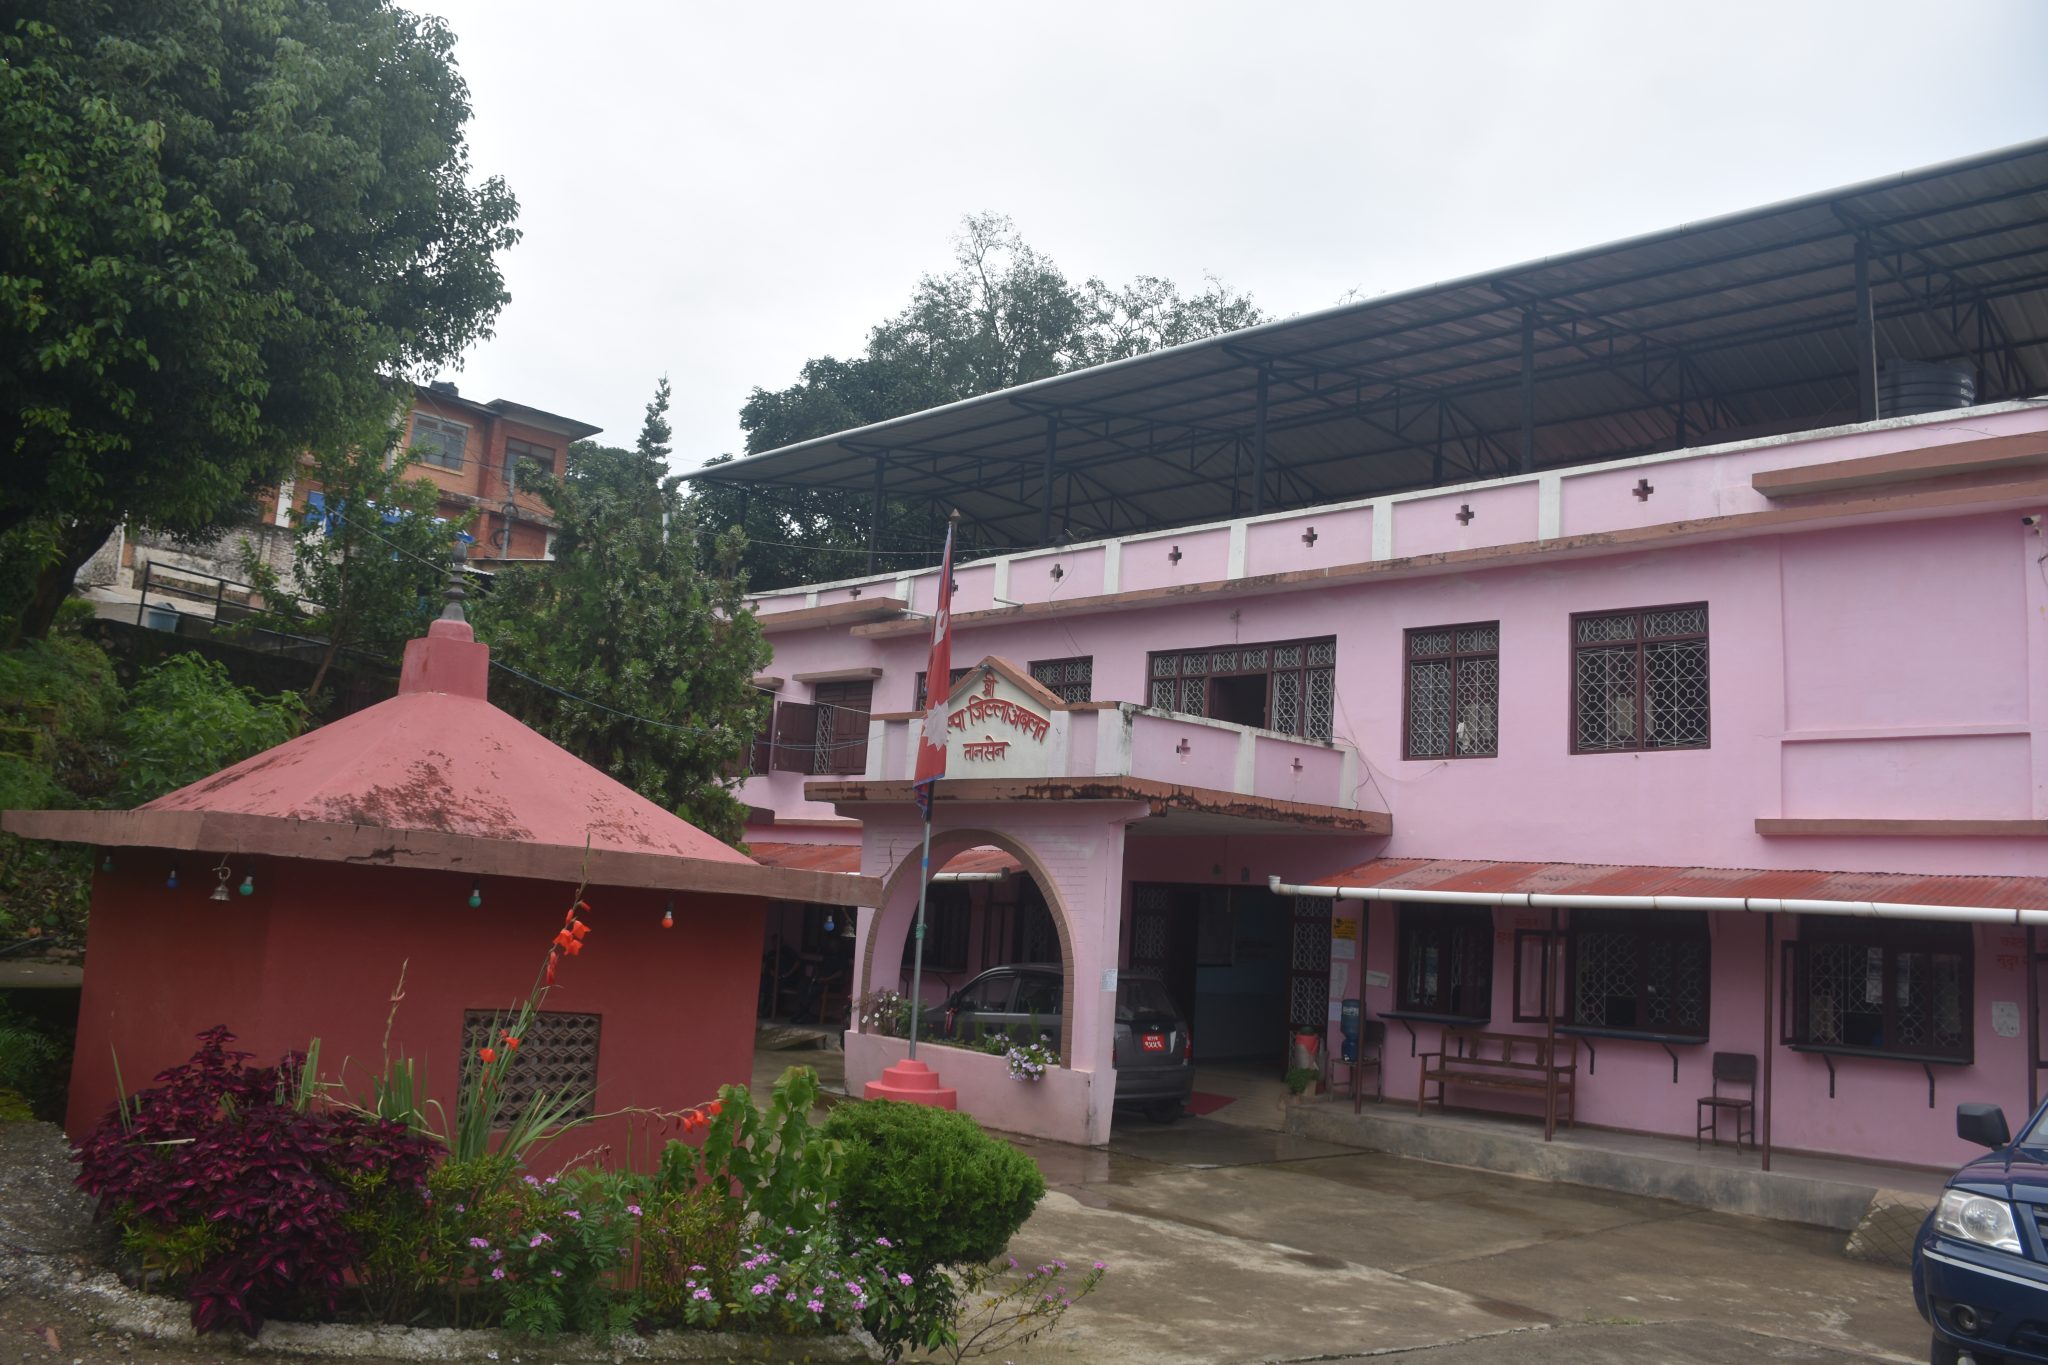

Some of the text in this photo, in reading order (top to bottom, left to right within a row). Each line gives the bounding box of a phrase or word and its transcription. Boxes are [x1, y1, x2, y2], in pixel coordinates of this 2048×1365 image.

[982, 670, 999, 698] श्री
[965, 694, 1013, 726] जिल्ला
[1008, 704, 1051, 744] अदालत
[963, 735, 1011, 761] तानसेन
